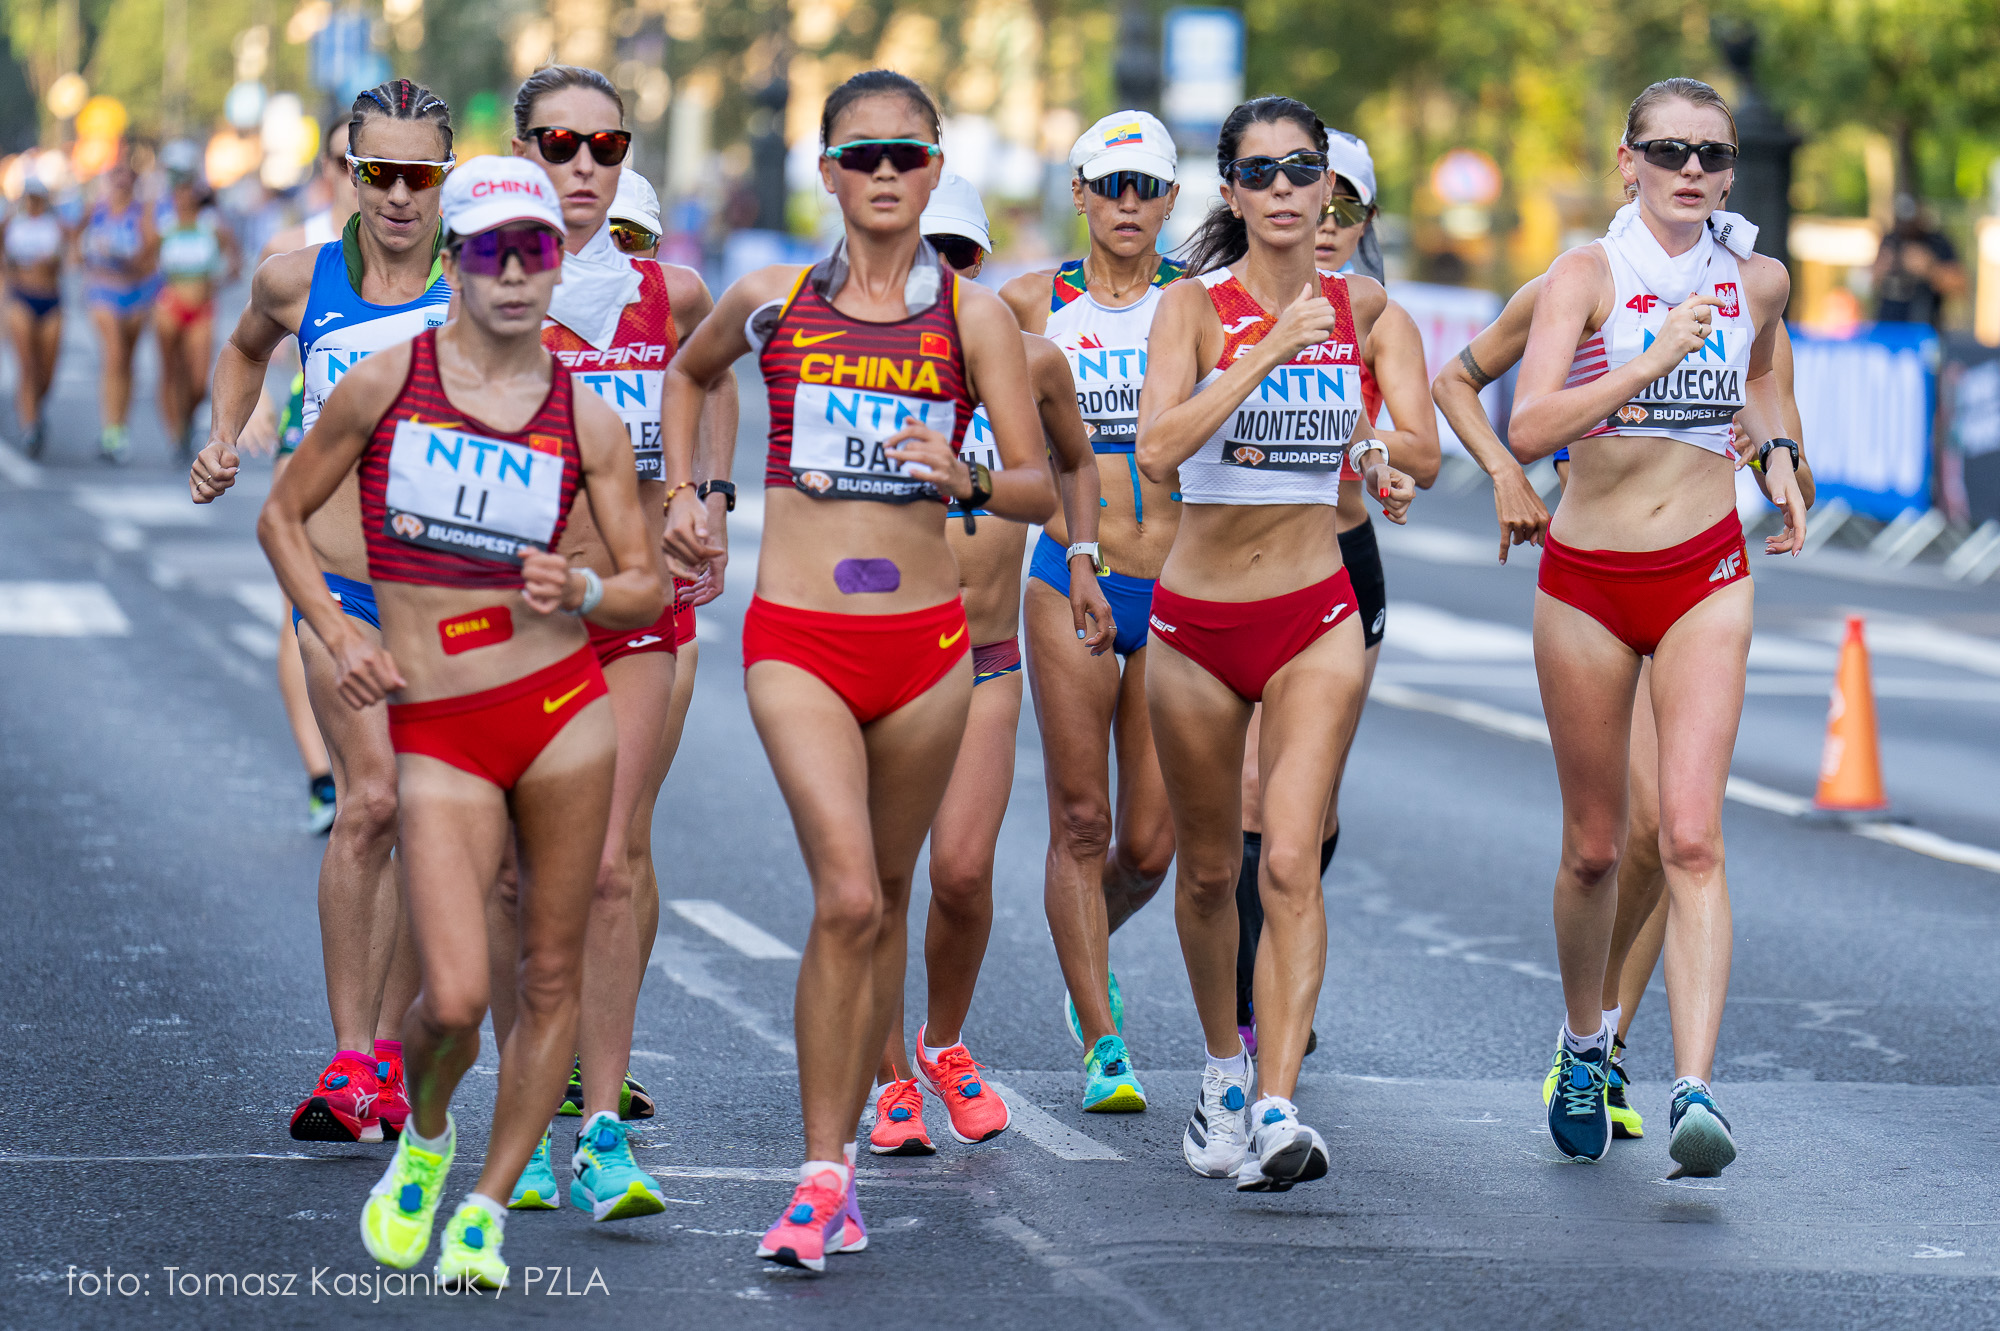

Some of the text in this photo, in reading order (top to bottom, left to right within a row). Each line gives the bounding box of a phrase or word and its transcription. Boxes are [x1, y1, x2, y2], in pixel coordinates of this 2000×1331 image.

[472, 180, 544, 198] CHINA
[552, 342, 666, 367] SPAÑA
[1233, 340, 1354, 362] EAÑA
[800, 353, 941, 394] CHINA
[1260, 368, 1345, 403] NTN
[576, 374, 647, 408] TN
[825, 390, 930, 431] NTN
[1100, 424, 1138, 435] BUDA
[425, 432, 533, 489] NTN
[453, 484, 488, 523] LI
[1708, 549, 1741, 582] 4F
[445, 617, 490, 638] CHINA
[1150, 614, 1177, 633] ESP
